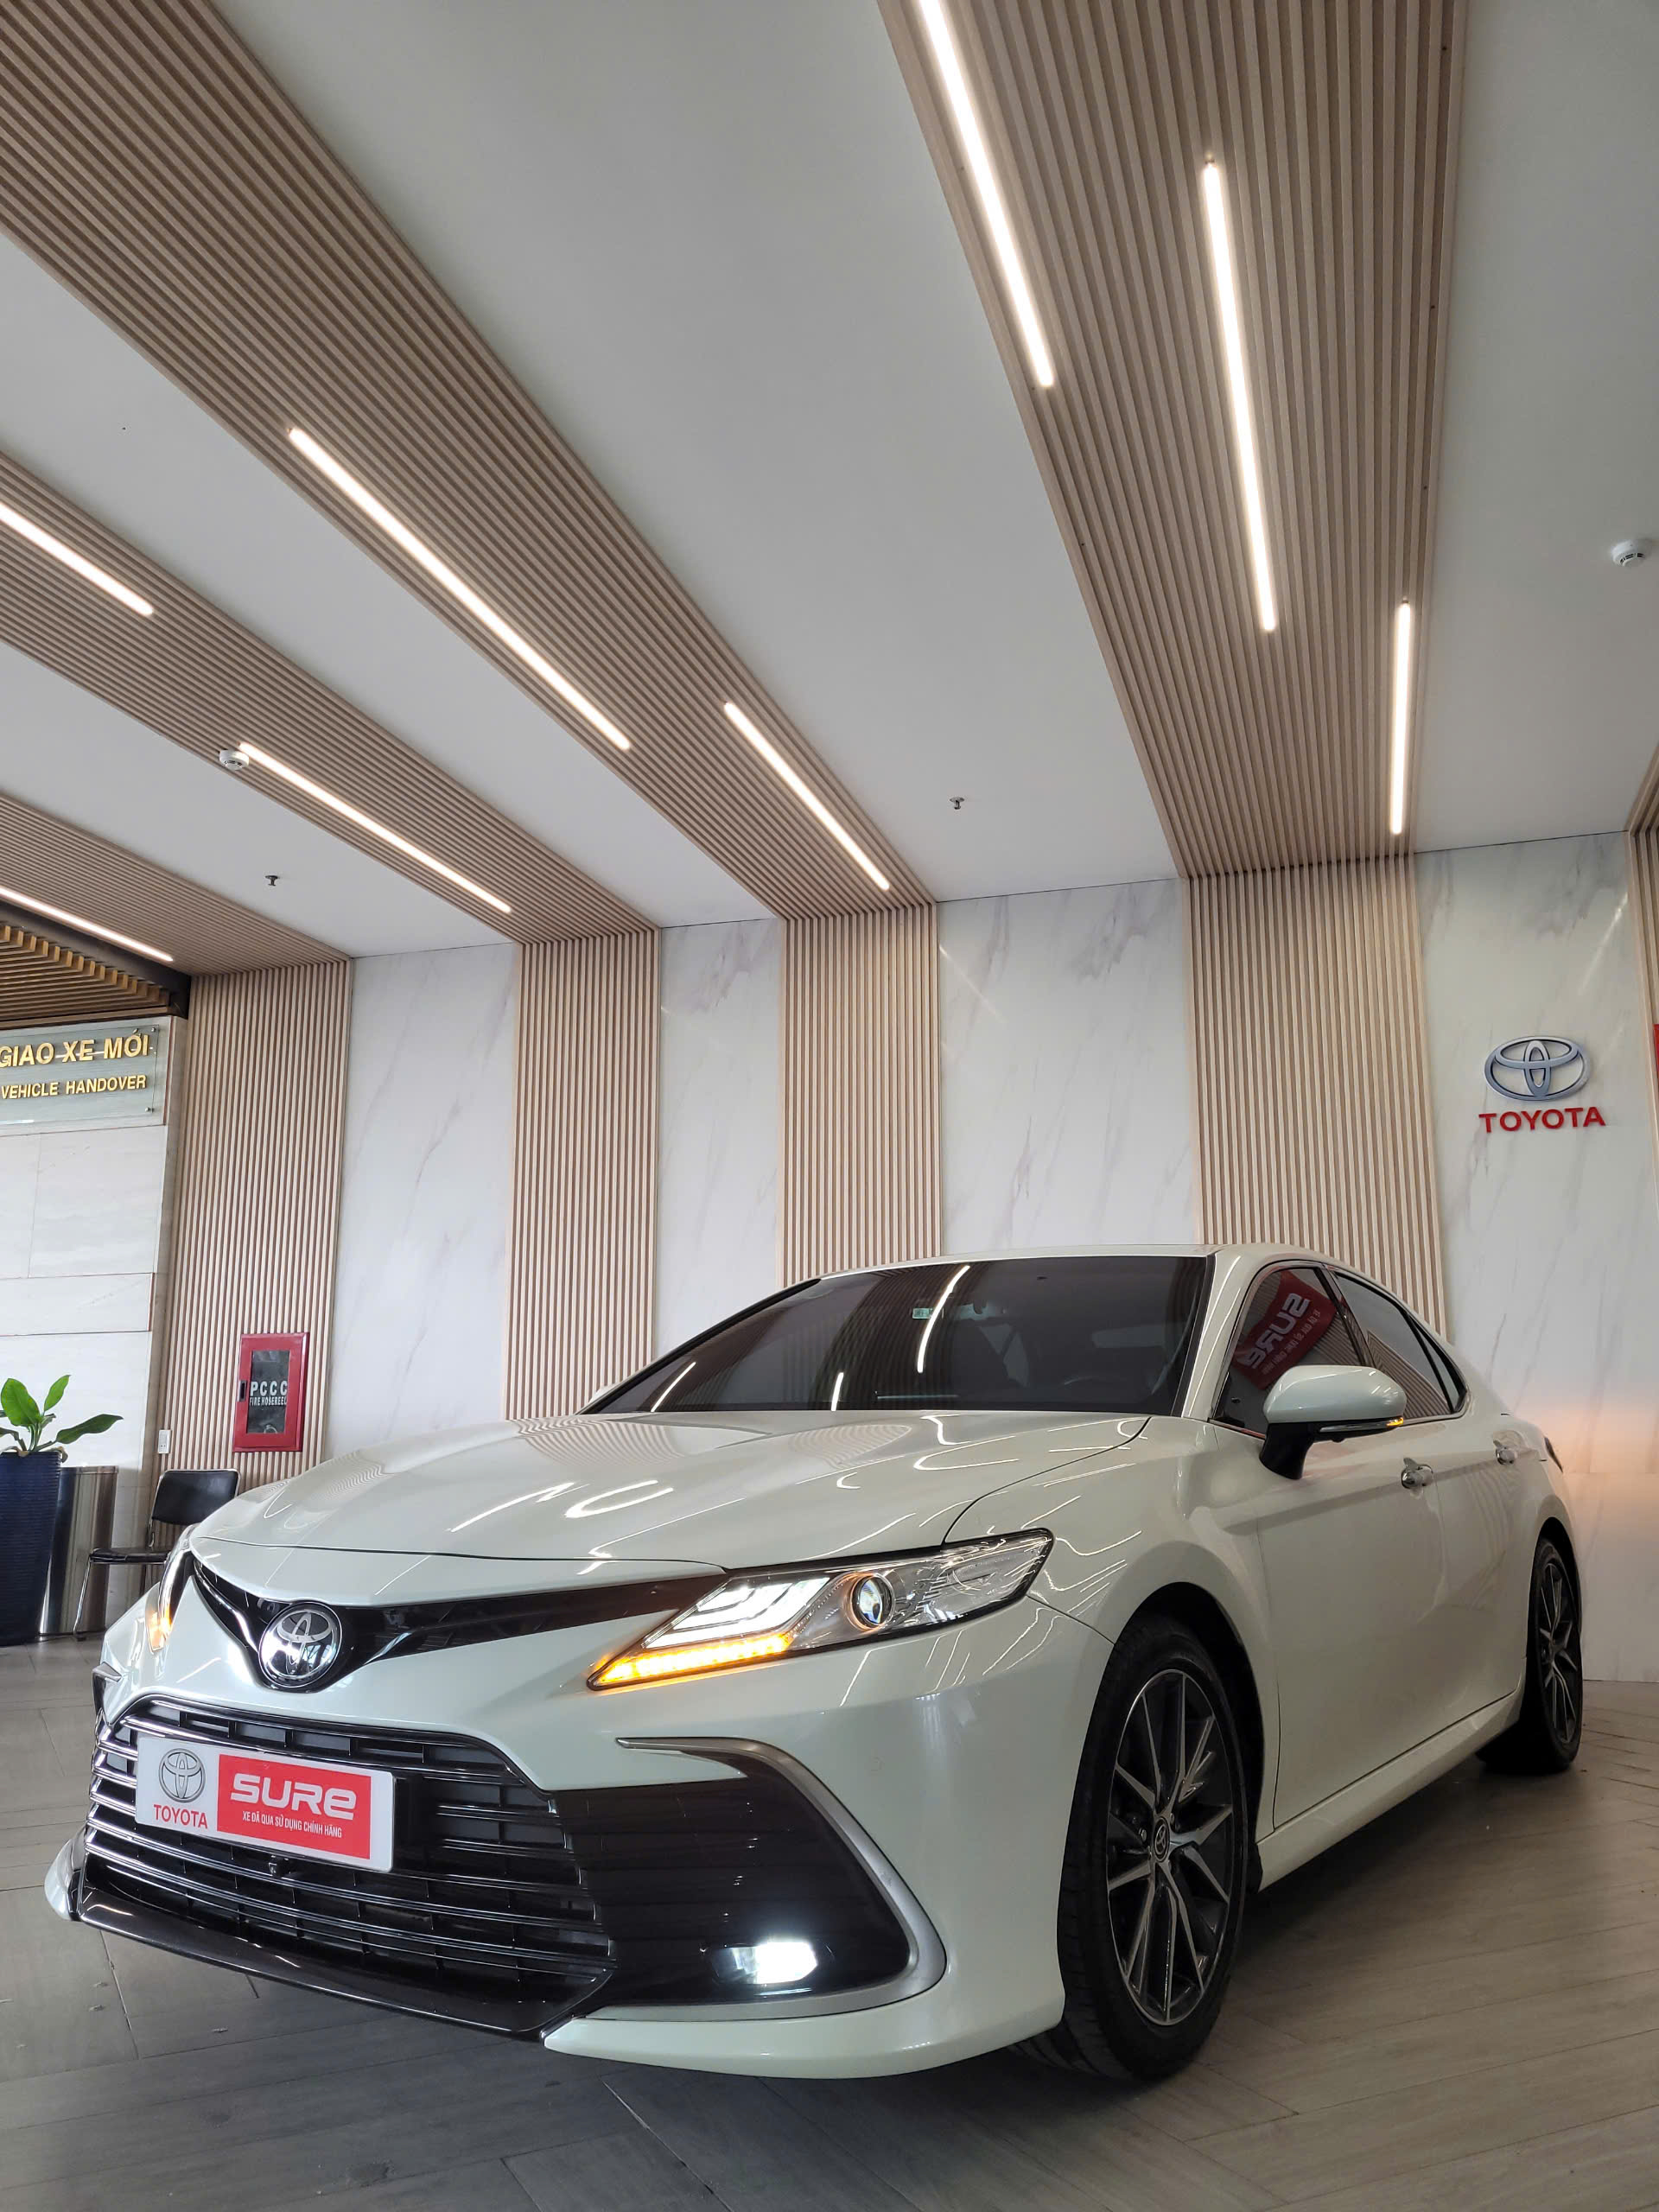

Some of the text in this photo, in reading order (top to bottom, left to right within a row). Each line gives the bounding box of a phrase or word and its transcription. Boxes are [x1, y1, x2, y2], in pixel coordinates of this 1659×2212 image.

[0, 1042, 54, 1068] GIAO
[62, 1039, 94, 1063] XE
[1, 1074, 147, 1100] VEHICLE HANDOVER
[1478, 1107, 1606, 1133] TOYOTA
[250, 1396, 261, 1406] FIRE
[154, 1803, 208, 1829] TOYOTA
[243, 1810, 251, 1821] XE
[261, 1814, 274, 1826] QUA
[303, 1820, 323, 1834] CHÍNH
